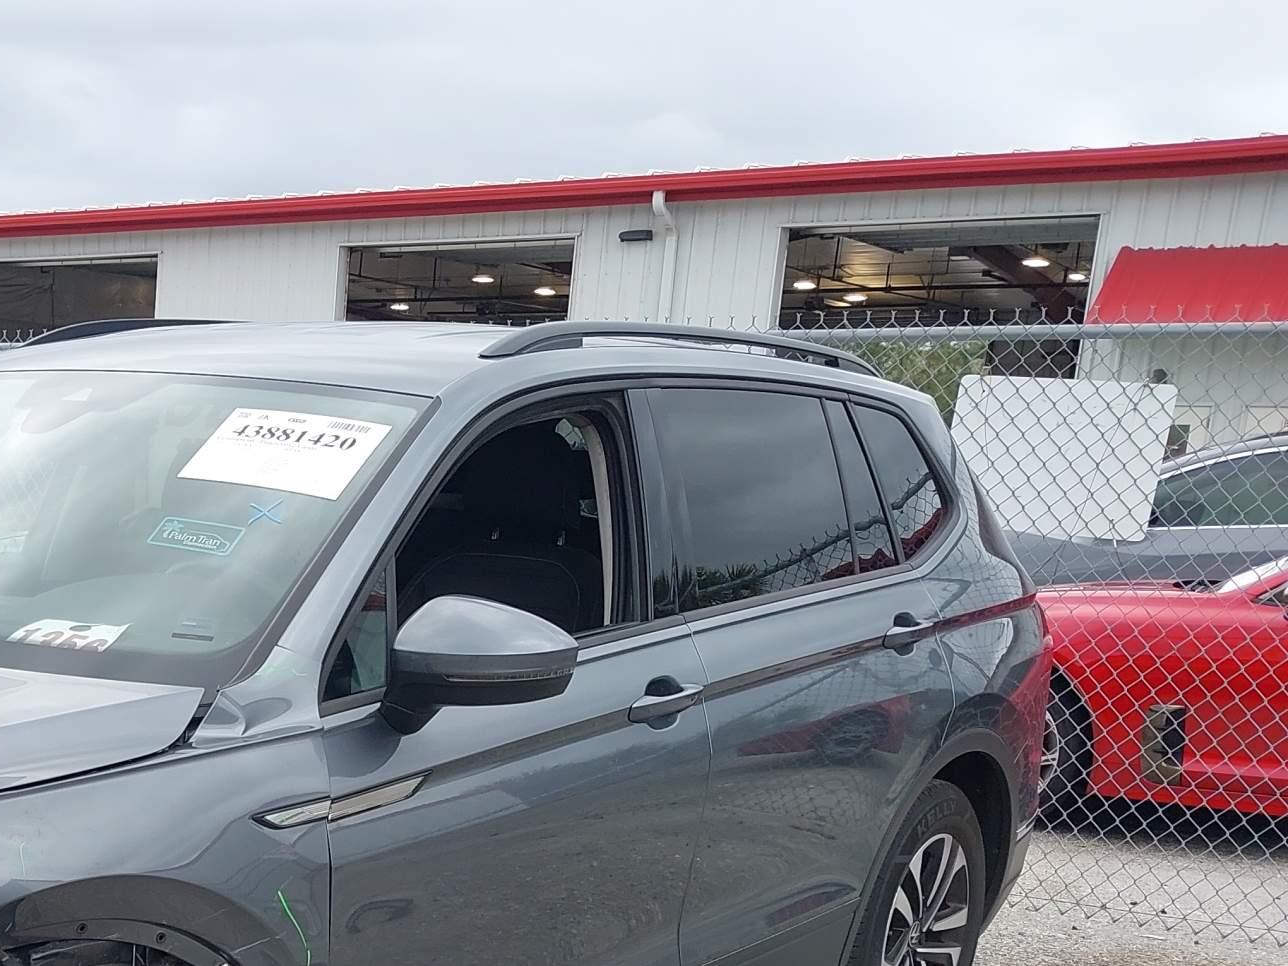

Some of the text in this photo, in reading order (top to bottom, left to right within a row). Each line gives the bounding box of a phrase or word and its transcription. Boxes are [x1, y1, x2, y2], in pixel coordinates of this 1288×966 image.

[232, 423, 358, 451] 43881420
[167, 529, 196, 543] Palm
[197, 535, 221, 547] Tran
[917, 799, 958, 836] KELLY
